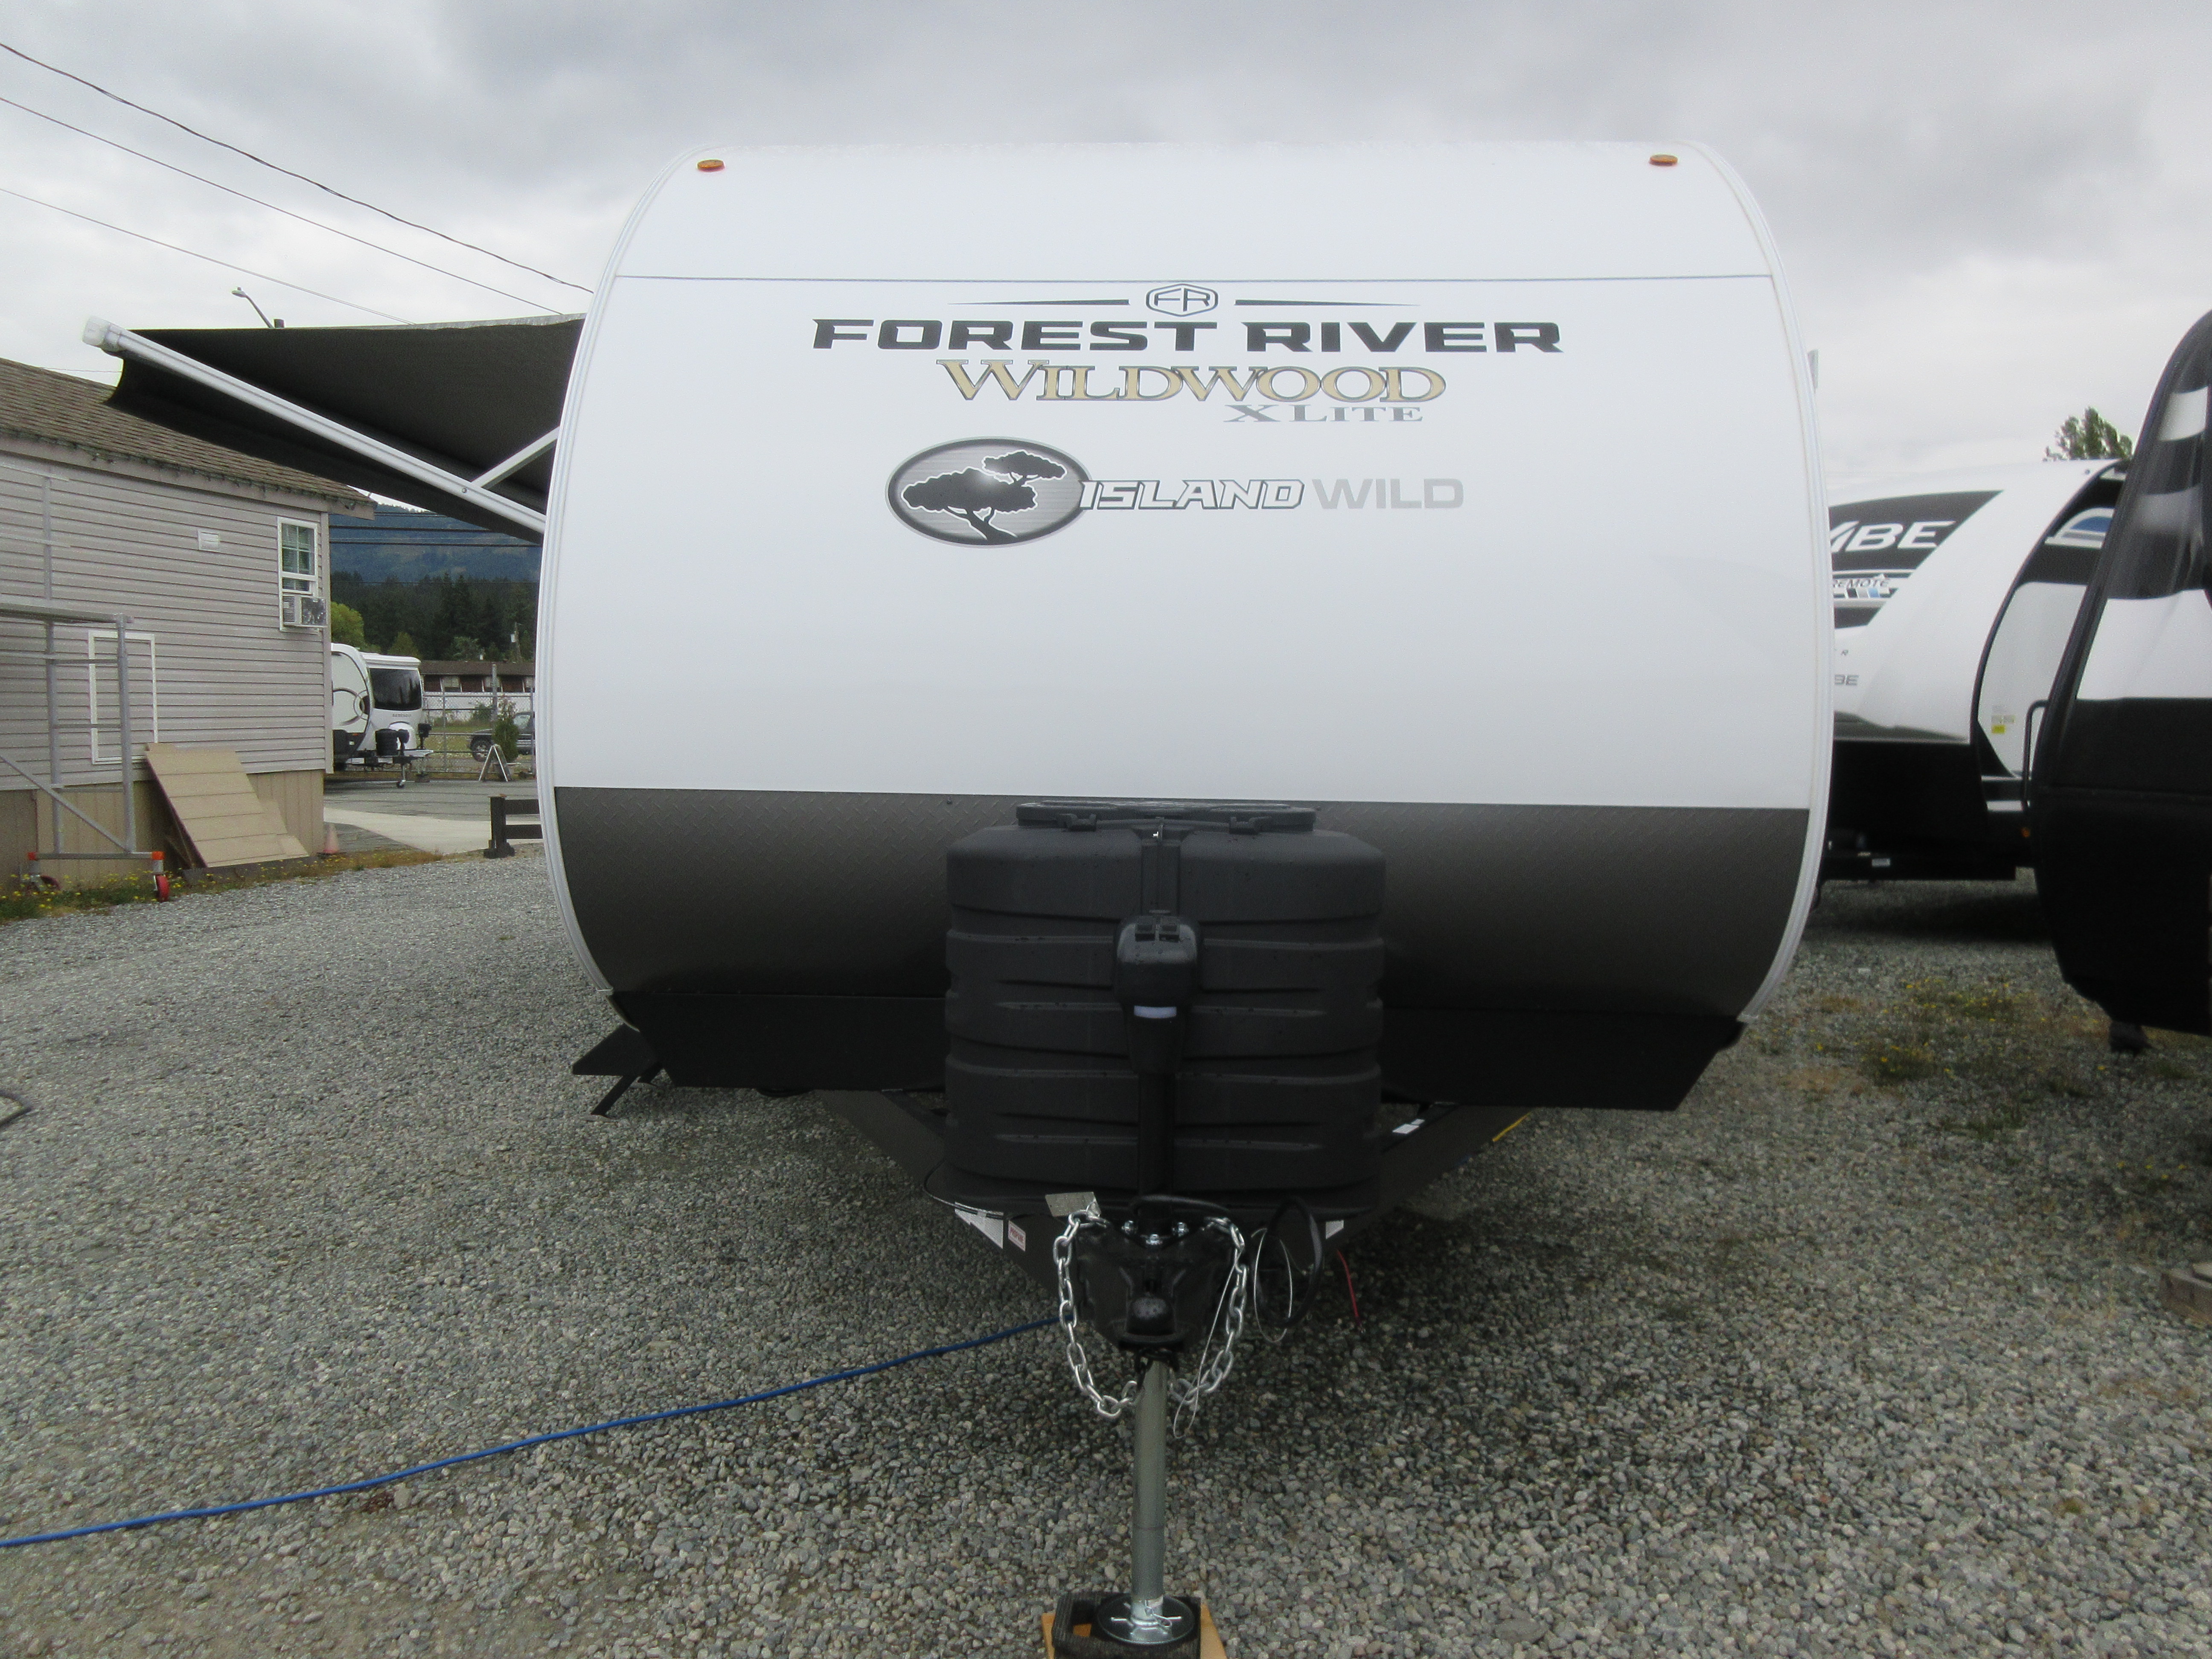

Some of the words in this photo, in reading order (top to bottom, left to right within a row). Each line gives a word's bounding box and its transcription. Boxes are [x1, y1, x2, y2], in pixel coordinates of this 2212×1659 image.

[812, 319, 1217, 351] FOREST
[1241, 322, 1564, 353] RIVER
[936, 359, 1447, 402] WILDWOOD
[1223, 404, 1281, 422] X
[1289, 404, 1423, 422] LITE
[1079, 479, 1305, 510] ISLAND
[1311, 478, 1465, 510] WILD
